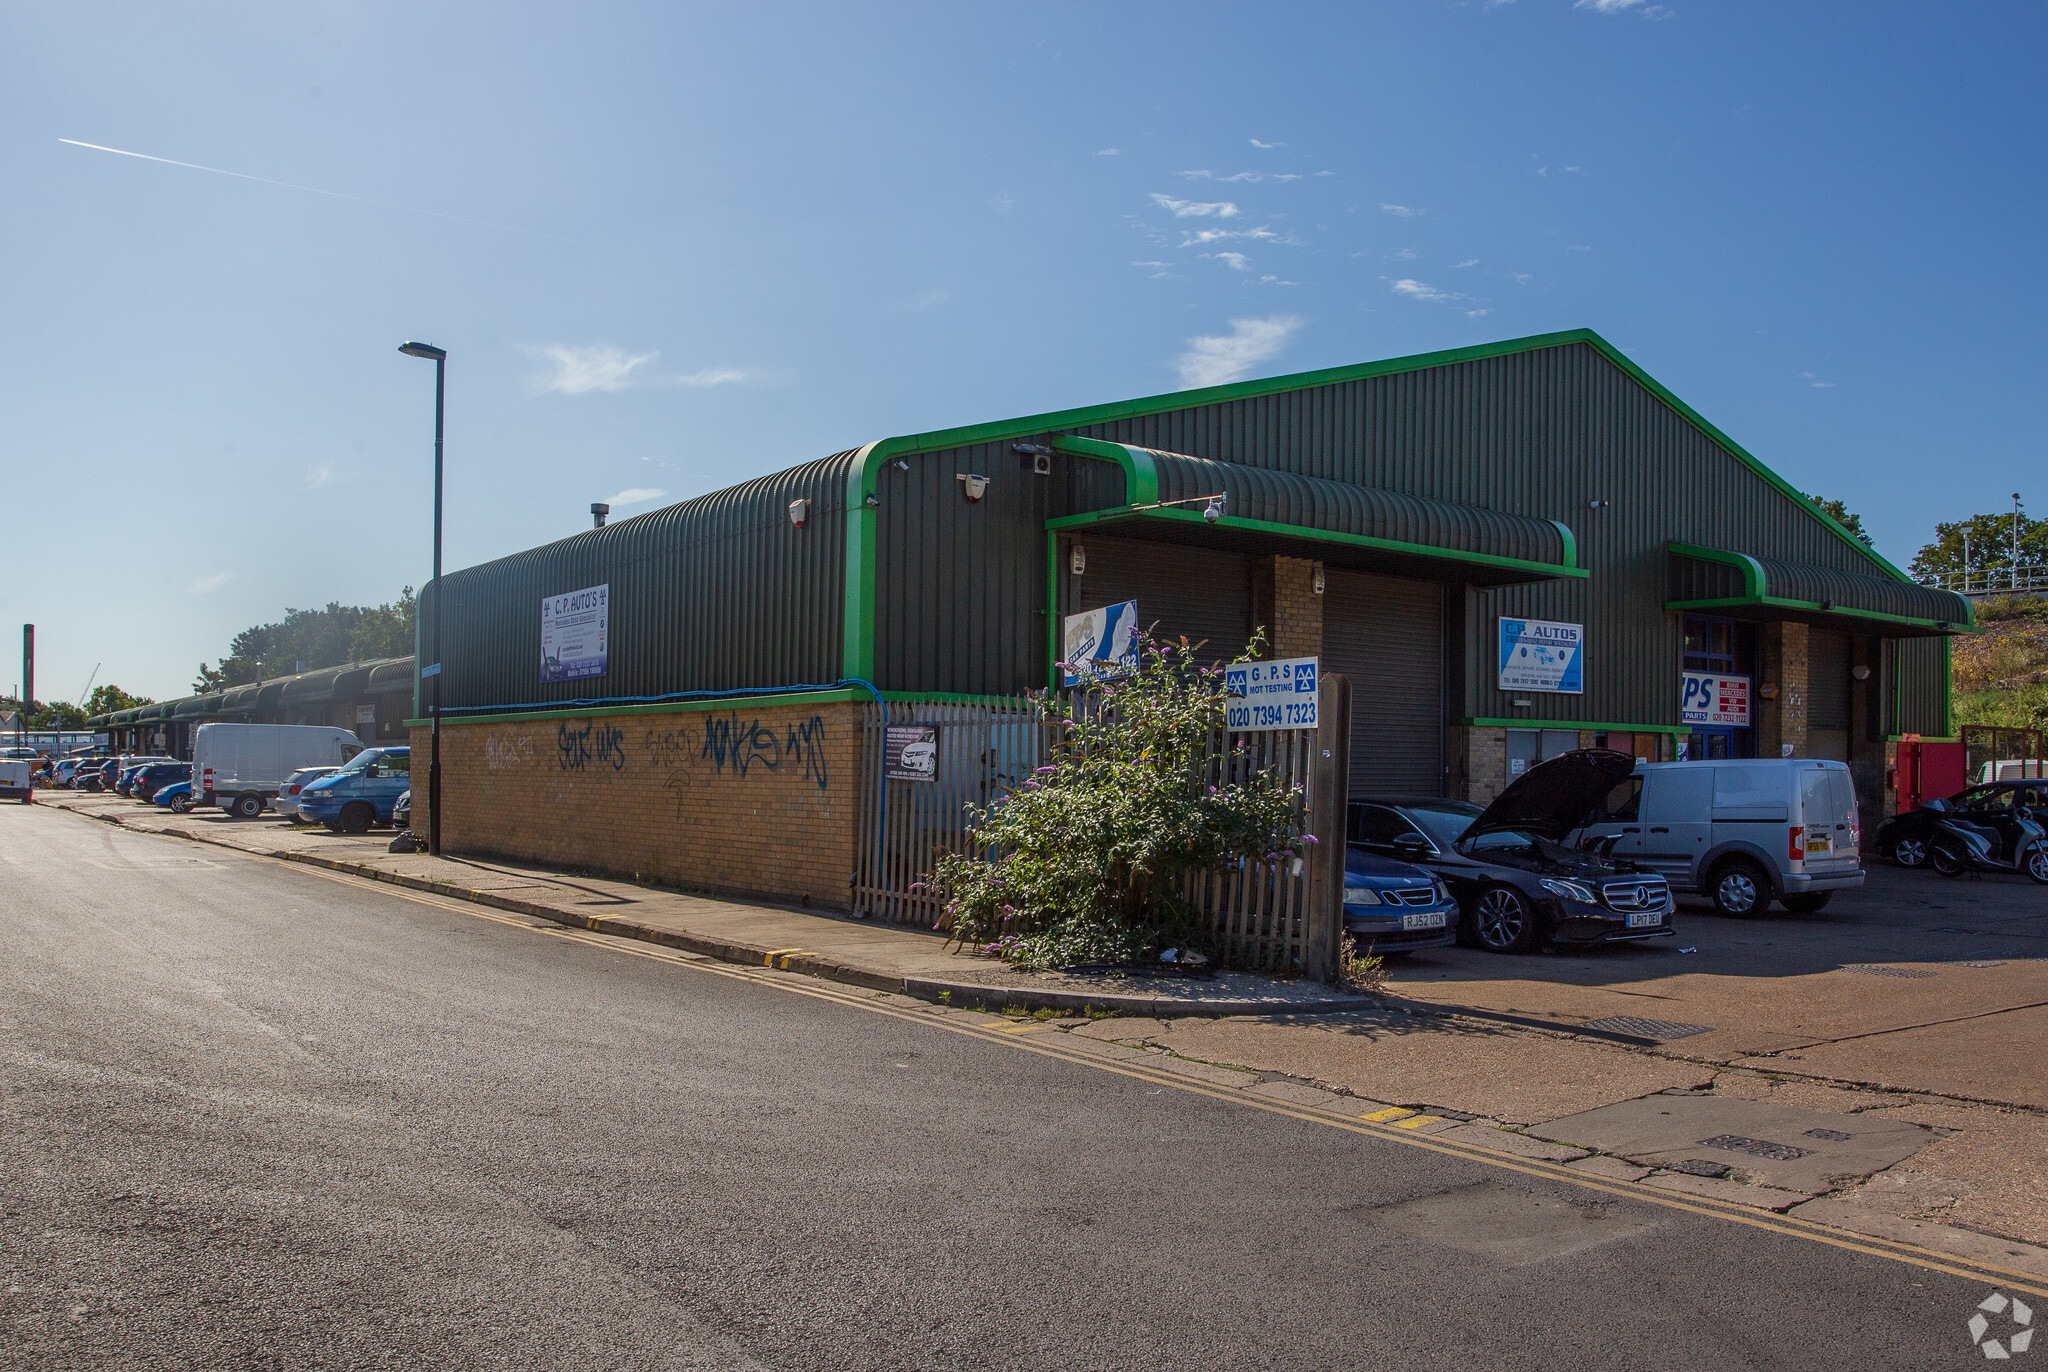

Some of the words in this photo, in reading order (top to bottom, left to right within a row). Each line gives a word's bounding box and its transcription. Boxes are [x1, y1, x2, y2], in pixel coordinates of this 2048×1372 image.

[1534, 626, 1577, 640] AUTOS
[1069, 651, 1079, 664] CAR
[1079, 637, 1095, 654] PARTS
[1250, 685, 1264, 694] MOT
[1265, 683, 1293, 694] TESTING
[1727, 681, 1740, 689] BMW
[1720, 688, 1746, 697] MERCEDES
[1229, 707, 1250, 727] 020
[1253, 704, 1282, 725] 7394
[1286, 702, 1316, 724] 7323
[1685, 712, 1707, 720] PARTS
[1723, 713, 1735, 722] 7232
[1736, 714, 1747, 723] 1122
[1407, 916, 1429, 928] RJ52
[1430, 914, 1444, 925] OZN
[1632, 914, 1647, 926] LP17
